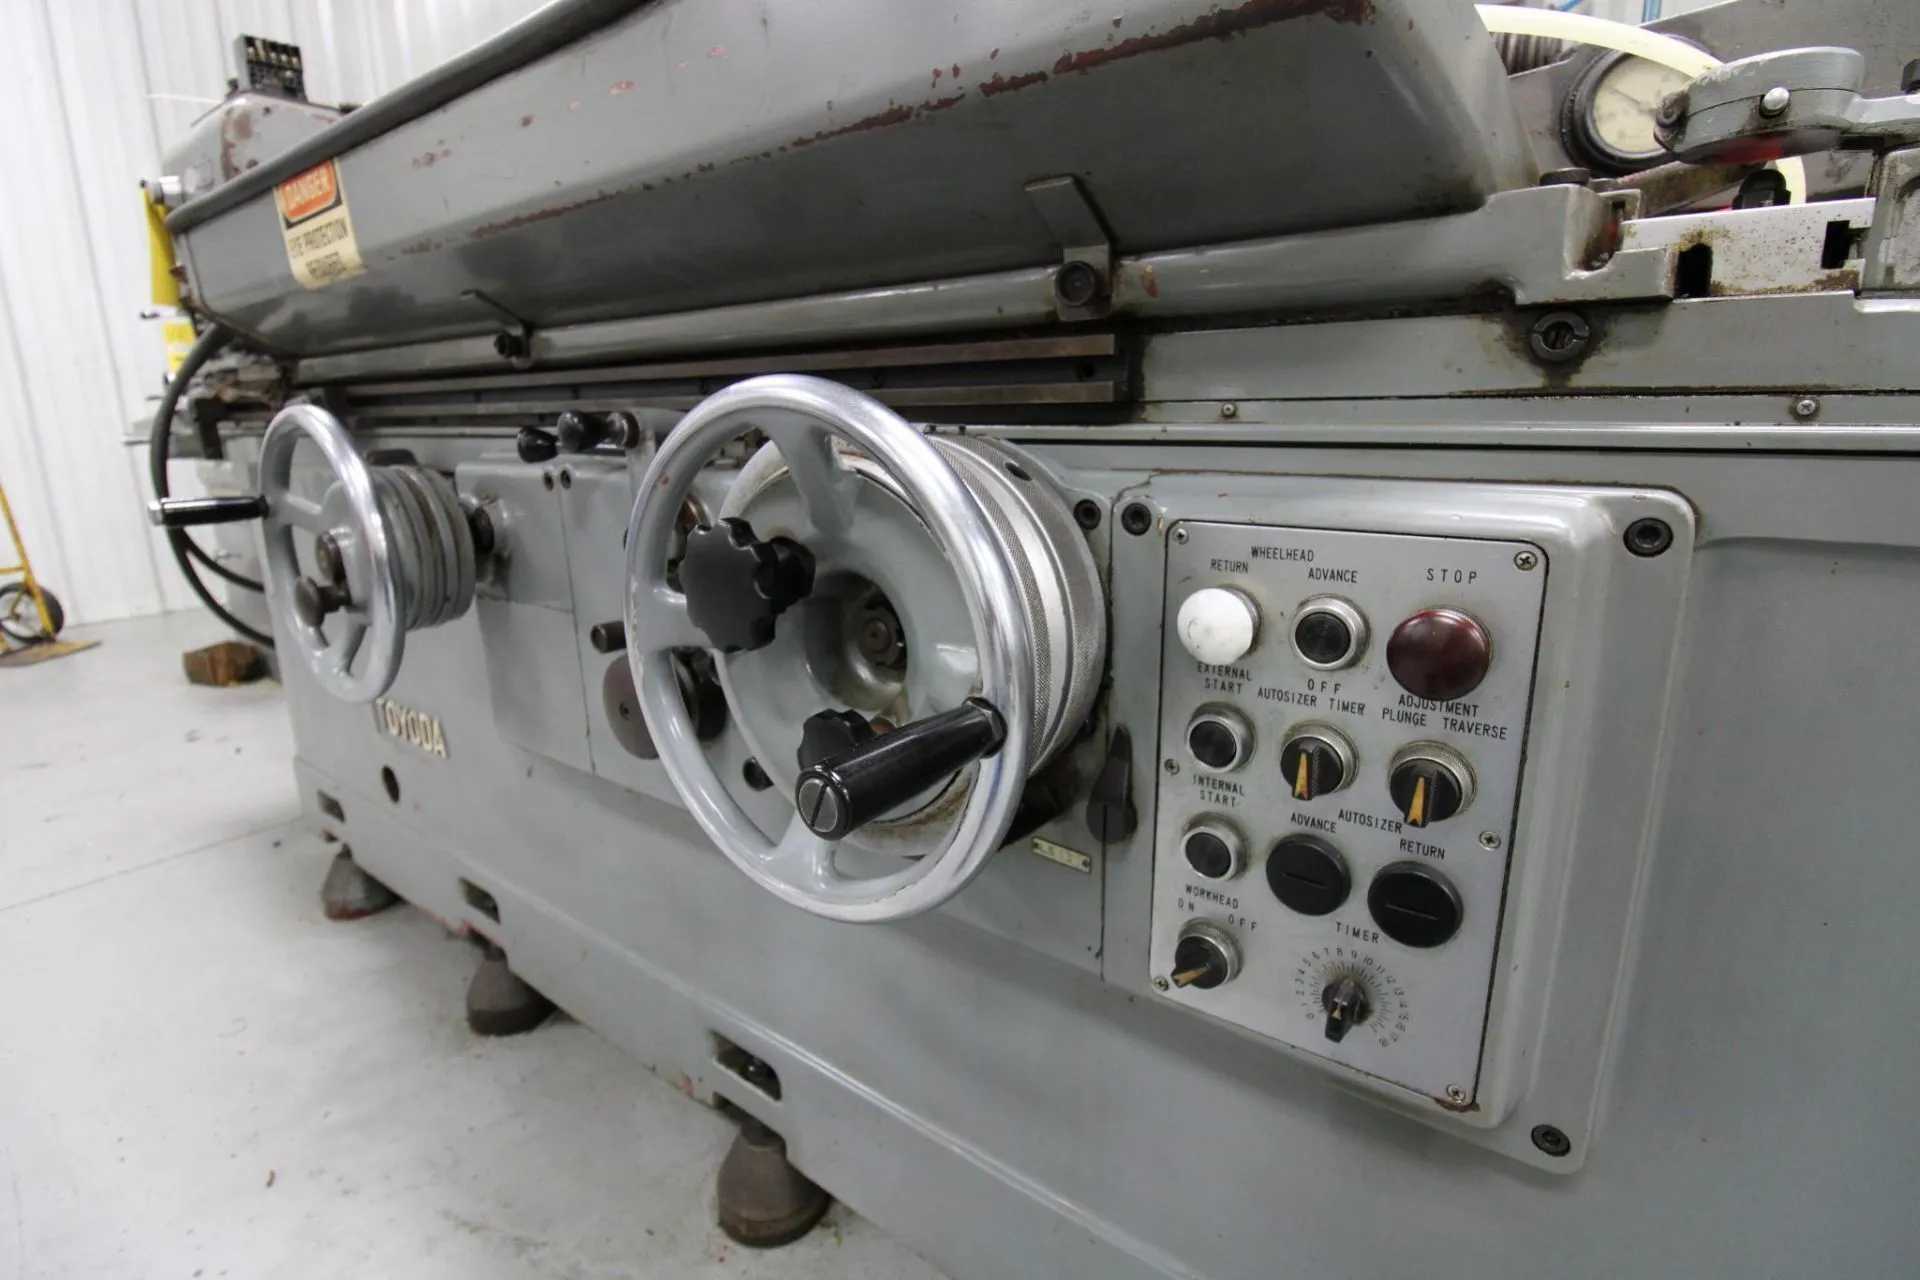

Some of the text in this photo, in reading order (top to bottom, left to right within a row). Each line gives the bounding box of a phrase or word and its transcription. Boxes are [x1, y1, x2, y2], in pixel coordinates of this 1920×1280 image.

[1250, 545, 1315, 562] WHEELHEAD
[1210, 558, 1249, 574] RETURN
[1308, 567, 1359, 584] ADVANCE
[1426, 567, 1478, 584] STOP
[1197, 663, 1252, 681] EXTERNAL
[1205, 677, 1242, 694] START
[1307, 678, 1342, 694] OFF
[1257, 686, 1365, 716] AUTOSIZER TIMER
[1398, 693, 1479, 718] ADJUSTMENT
[1382, 707, 1508, 740] PLUNGE TRAVERSE
[1193, 775, 1244, 796] INTERNAL
[1200, 789, 1236, 808] START
[1290, 812, 1337, 833] ADVANCE
[1338, 808, 1403, 834] AUTOSIZER
[1400, 838, 1445, 860] RETURN
[1185, 884, 1239, 910] WORKHEAD
[1336, 921, 1380, 944] TIMER
